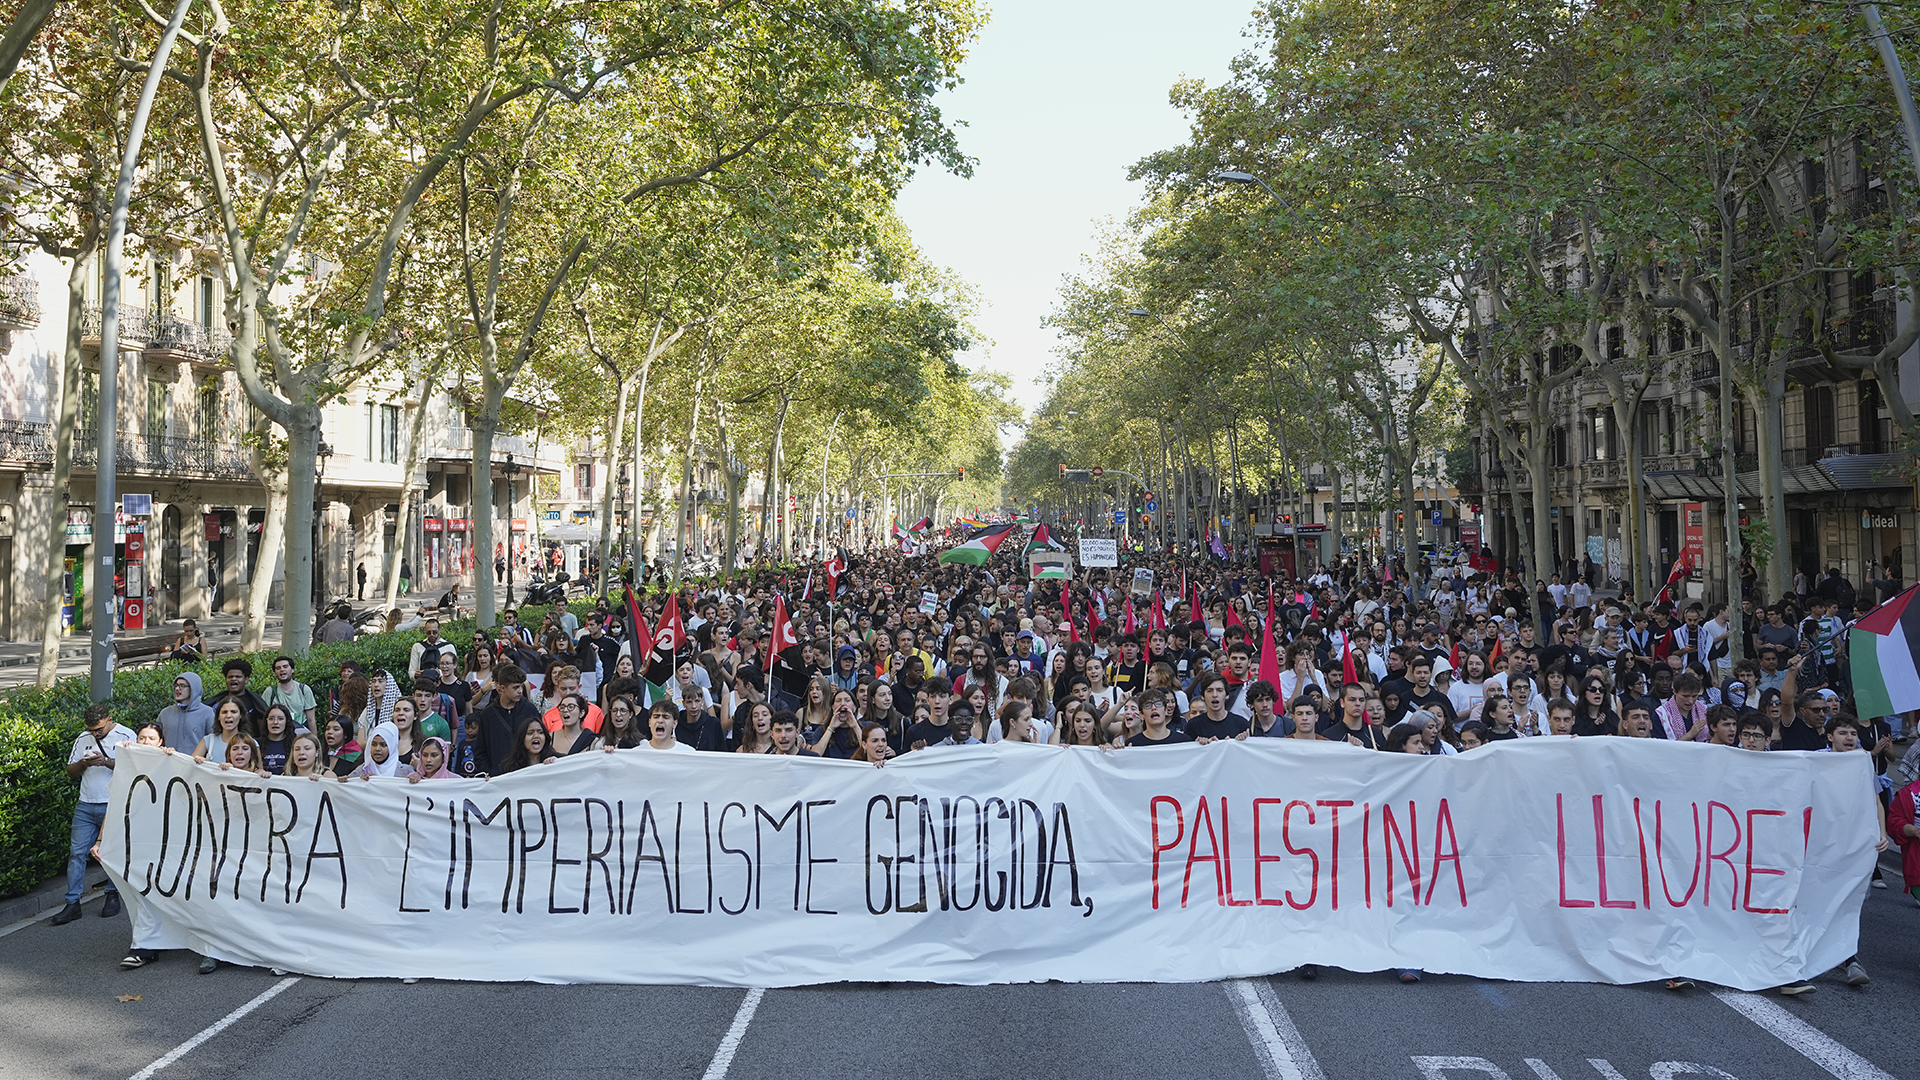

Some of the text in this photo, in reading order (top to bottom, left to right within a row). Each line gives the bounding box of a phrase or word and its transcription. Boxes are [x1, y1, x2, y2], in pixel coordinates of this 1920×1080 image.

[1433, 511, 1440, 520] P
[1738, 515, 1749, 527] eal
[1871, 514, 1898, 528] ideal
[1082, 553, 1090, 561] ES
[124, 774, 347, 909] CONTRA
[399, 796, 838, 915] L'IMPERIALISME
[866, 794, 1095, 918] GENOCIDA,
[1150, 795, 1468, 910] PALESTINA
